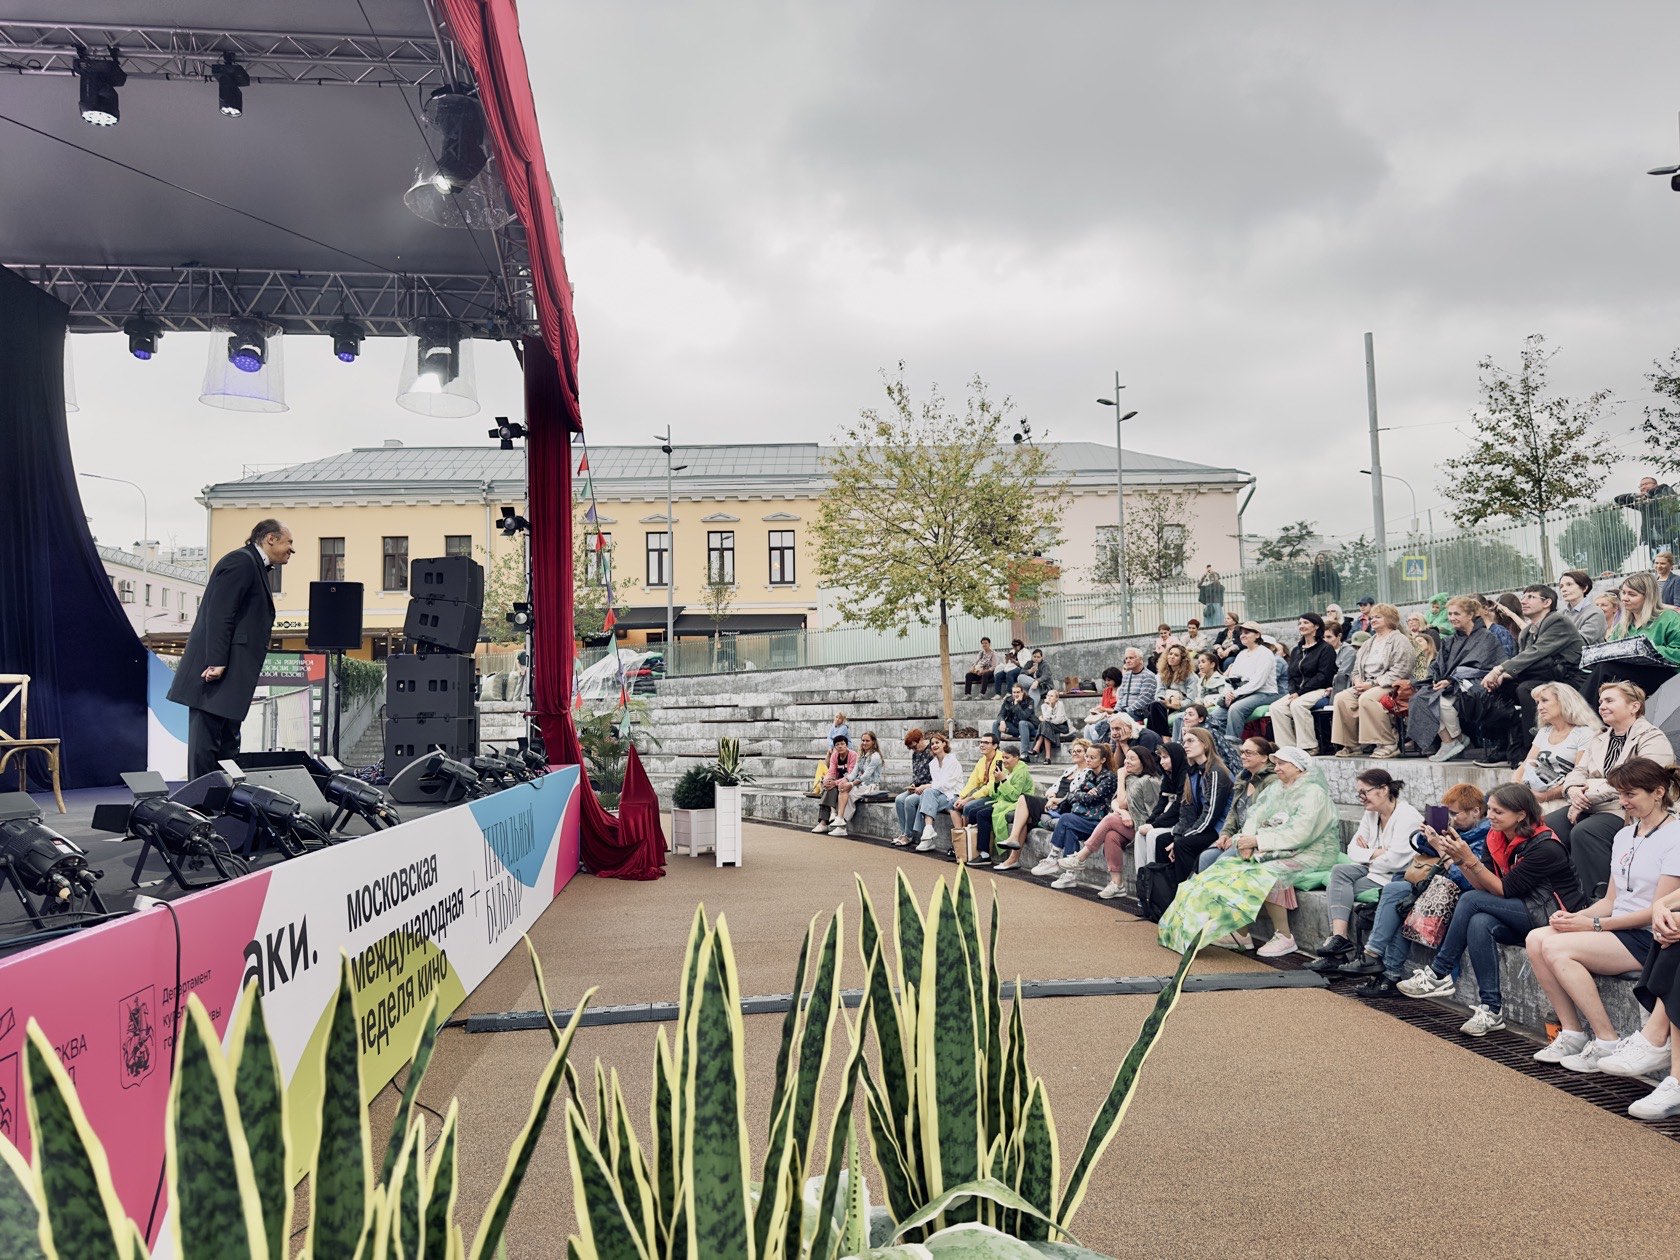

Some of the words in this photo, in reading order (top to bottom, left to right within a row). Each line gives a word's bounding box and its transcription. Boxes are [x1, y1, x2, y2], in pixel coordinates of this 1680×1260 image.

[482, 802, 535, 881] ТЕАТРАЛЬНЫЙ
[347, 854, 438, 932] московская
[486, 869, 523, 945] БУЛЬВАР
[351, 887, 464, 994] международная
[418, 949, 448, 1002] кино
